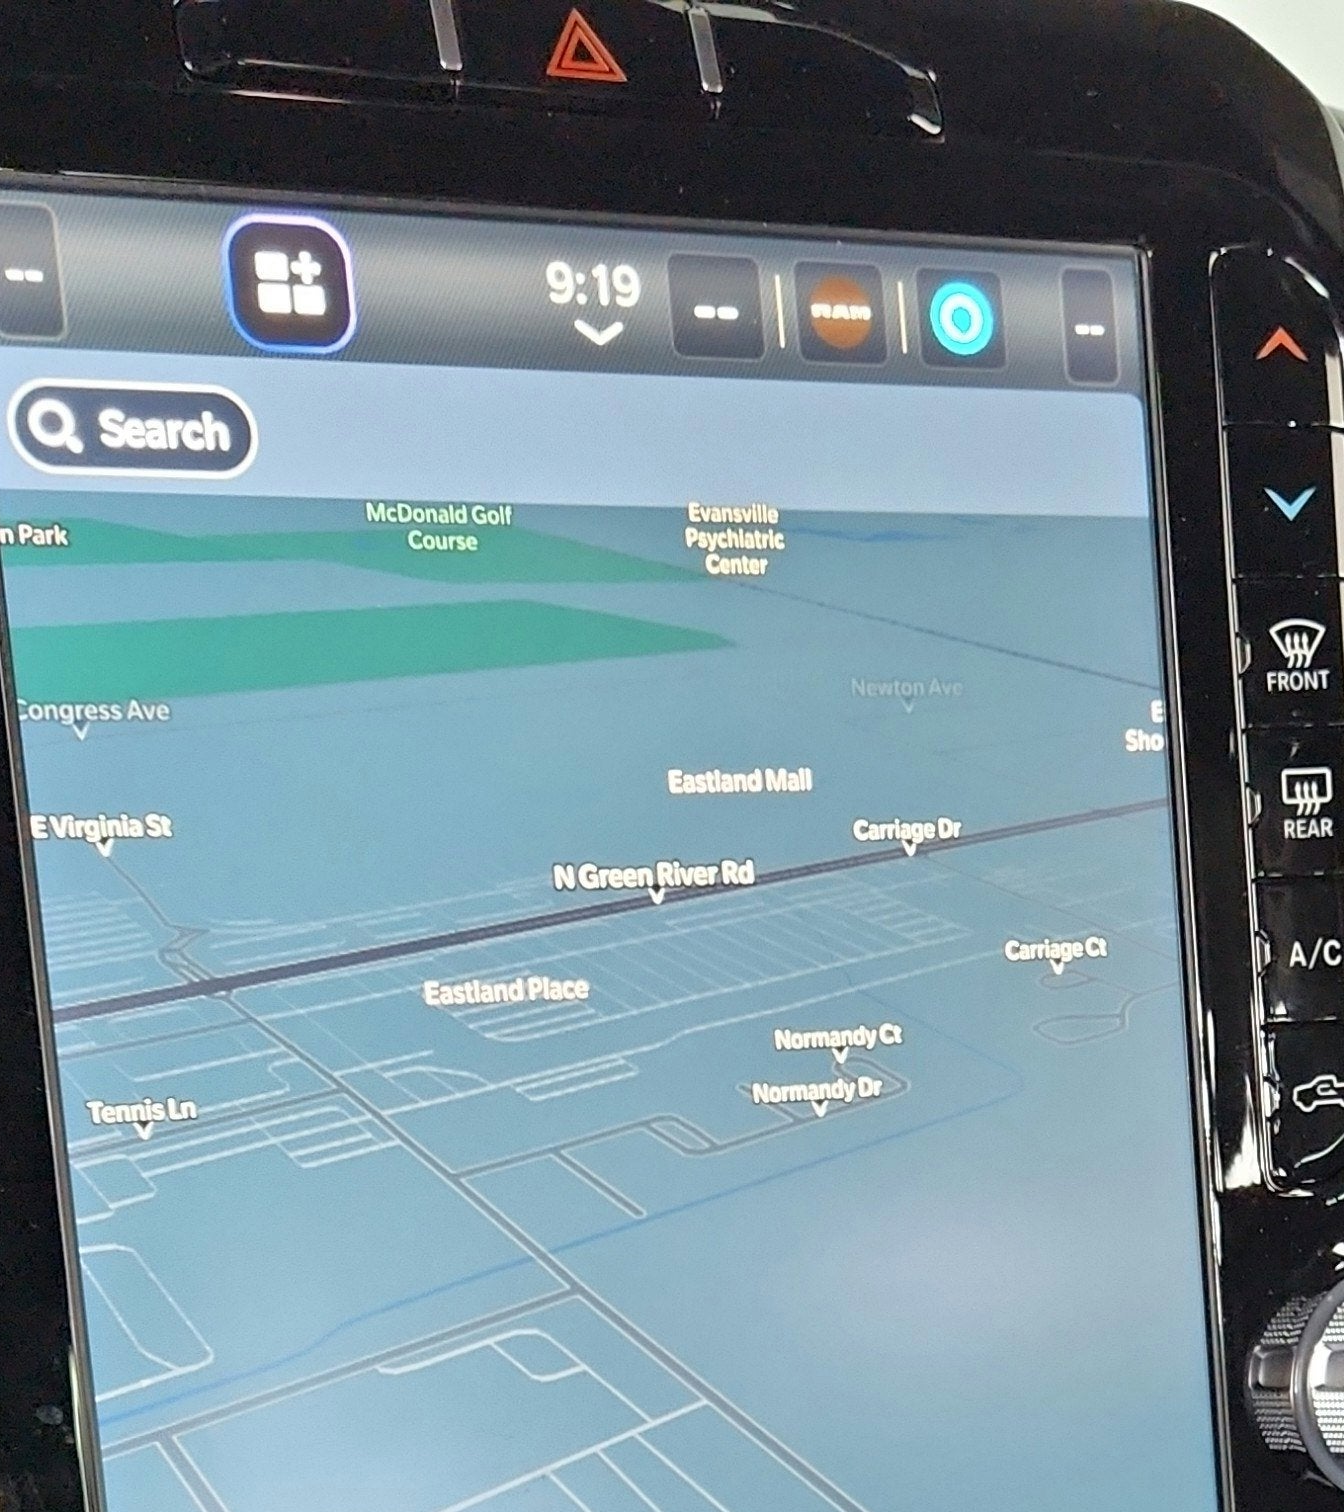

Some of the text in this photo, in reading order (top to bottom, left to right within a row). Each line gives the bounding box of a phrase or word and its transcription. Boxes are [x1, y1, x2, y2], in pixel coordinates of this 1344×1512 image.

[546, 261, 641, 308] 9:19
[98, 407, 231, 453] Search
[366, 502, 513, 526] McDonald Golf
[688, 502, 779, 525] Evansville
[18, 523, 69, 546] Park
[407, 530, 478, 552] Course
[685, 526, 785, 552] Psychiatric
[705, 552, 769, 576] Center
[851, 677, 925, 697] Newton
[1266, 668, 1331, 692] FRONT
[17, 698, 171, 725] Congress Ave
[1125, 728, 1165, 752] Sho
[668, 768, 813, 795] Eastland Mall
[30, 813, 173, 844] E Virginia St
[853, 818, 962, 846] Carriage Dr
[1283, 818, 1334, 840] REAR
[553, 860, 755, 890] N Green River Rd
[1004, 937, 1108, 965] Carriage Ct
[1288, 938, 1343, 970] A/C
[423, 976, 590, 1006] Eastland Place
[774, 1023, 903, 1053] Normandy Ct
[753, 1076, 883, 1106] Normandy Dr
[86, 1099, 199, 1125] Tennis Ln
